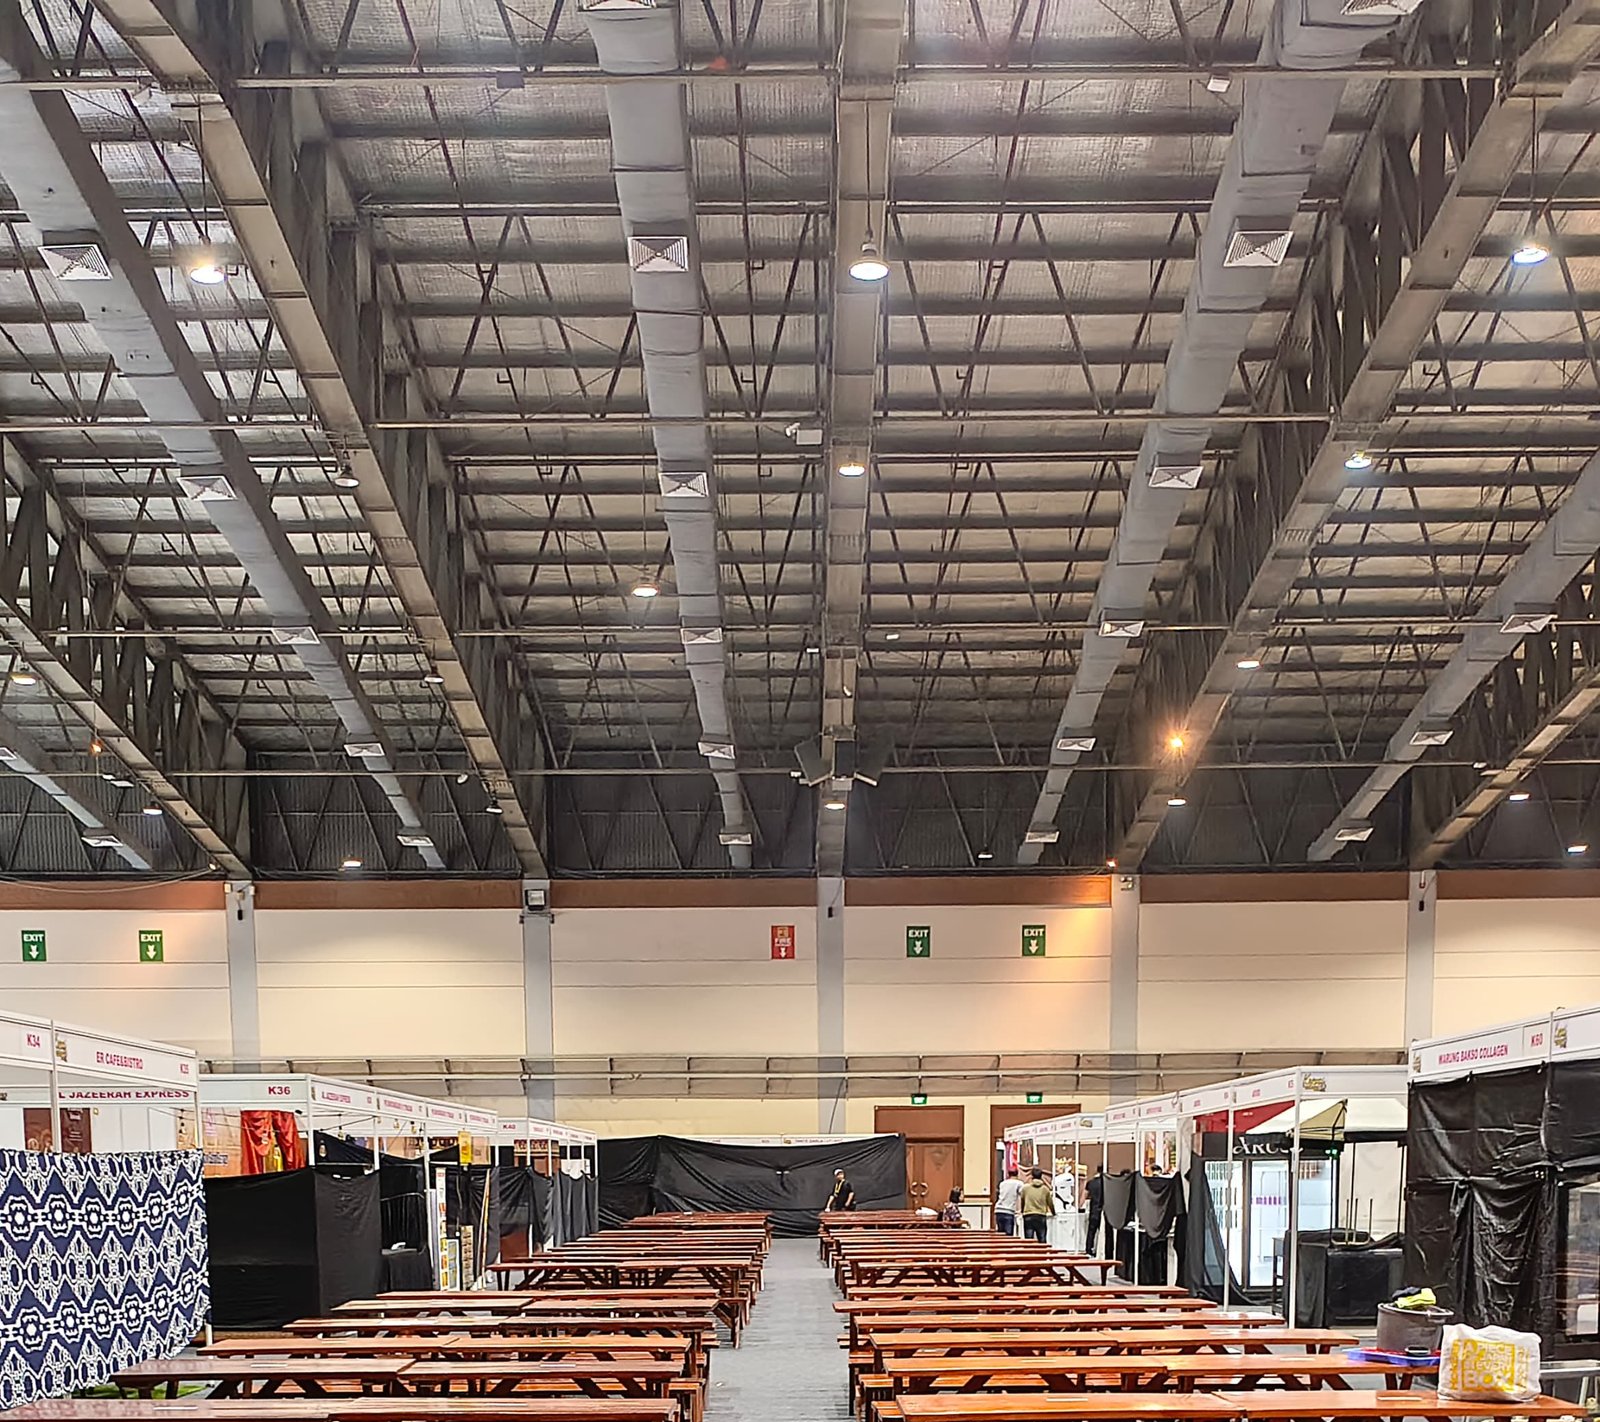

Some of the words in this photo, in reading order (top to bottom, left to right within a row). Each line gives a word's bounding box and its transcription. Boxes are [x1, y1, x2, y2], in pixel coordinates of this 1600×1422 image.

[908, 929, 929, 937] EXIT
[23, 934, 44, 942] EXIT
[141, 934, 162, 942] EXIT
[27, 1033, 41, 1048] K34
[1460, 1048, 1478, 1062] BAKSO
[1479, 1044, 1508, 1059] COLLAGEN
[135, 1090, 190, 1099] EXPRESS
[268, 1086, 291, 1095] K36
[1464, 1370, 1511, 1388] BOX
